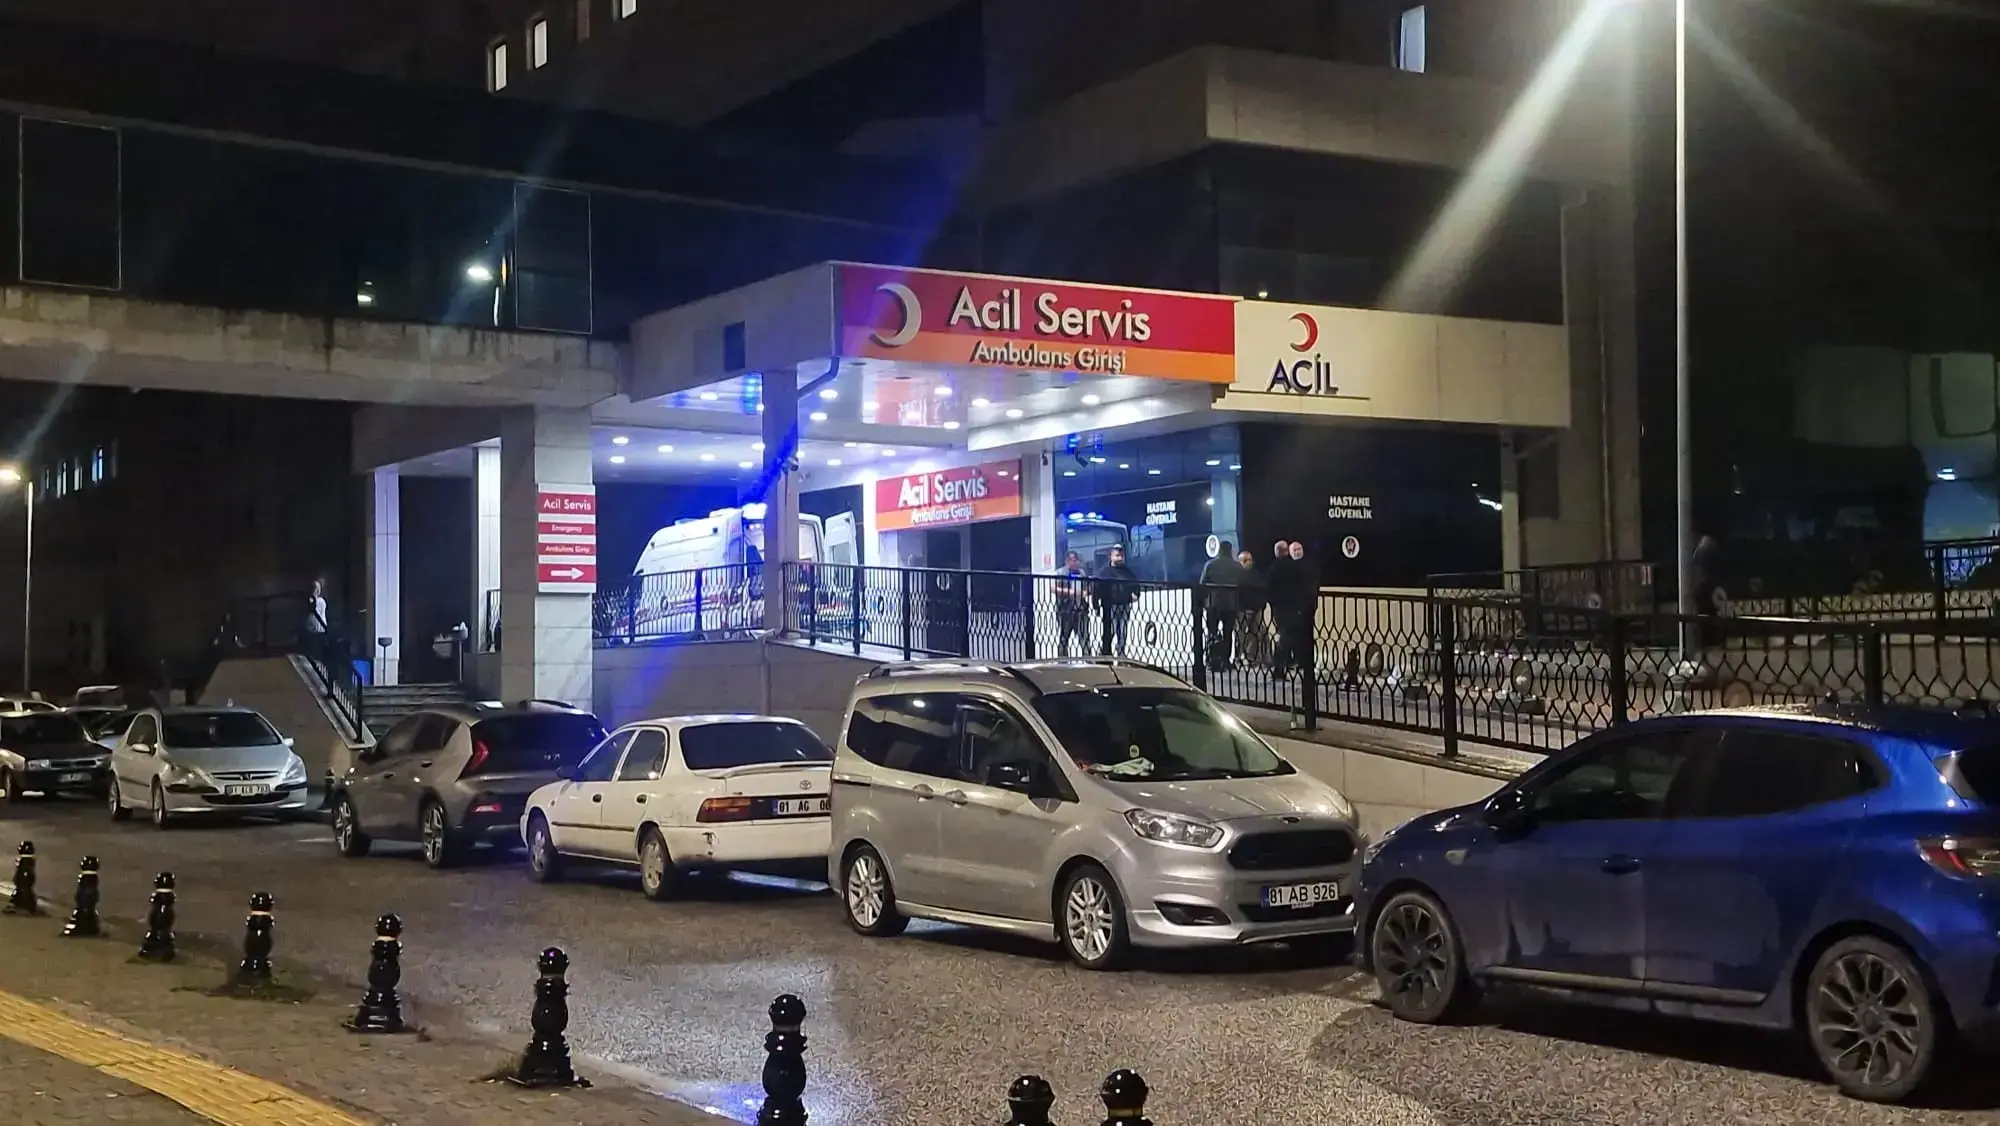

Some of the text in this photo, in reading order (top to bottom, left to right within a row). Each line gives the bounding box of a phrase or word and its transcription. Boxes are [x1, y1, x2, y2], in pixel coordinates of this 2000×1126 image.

[948, 285, 1151, 342] Acil Servis
[972, 341, 1126, 373] Ambulans Girişi
[1266, 353, 1339, 394] ACİL
[898, 468, 987, 508] Acil Servis
[543, 498, 591, 510] Acil Servis
[1328, 506, 1373, 519] GÜVENLİK
[1330, 495, 1370, 507] HASTANE
[1269, 885, 1336, 904] 81 AB 926
